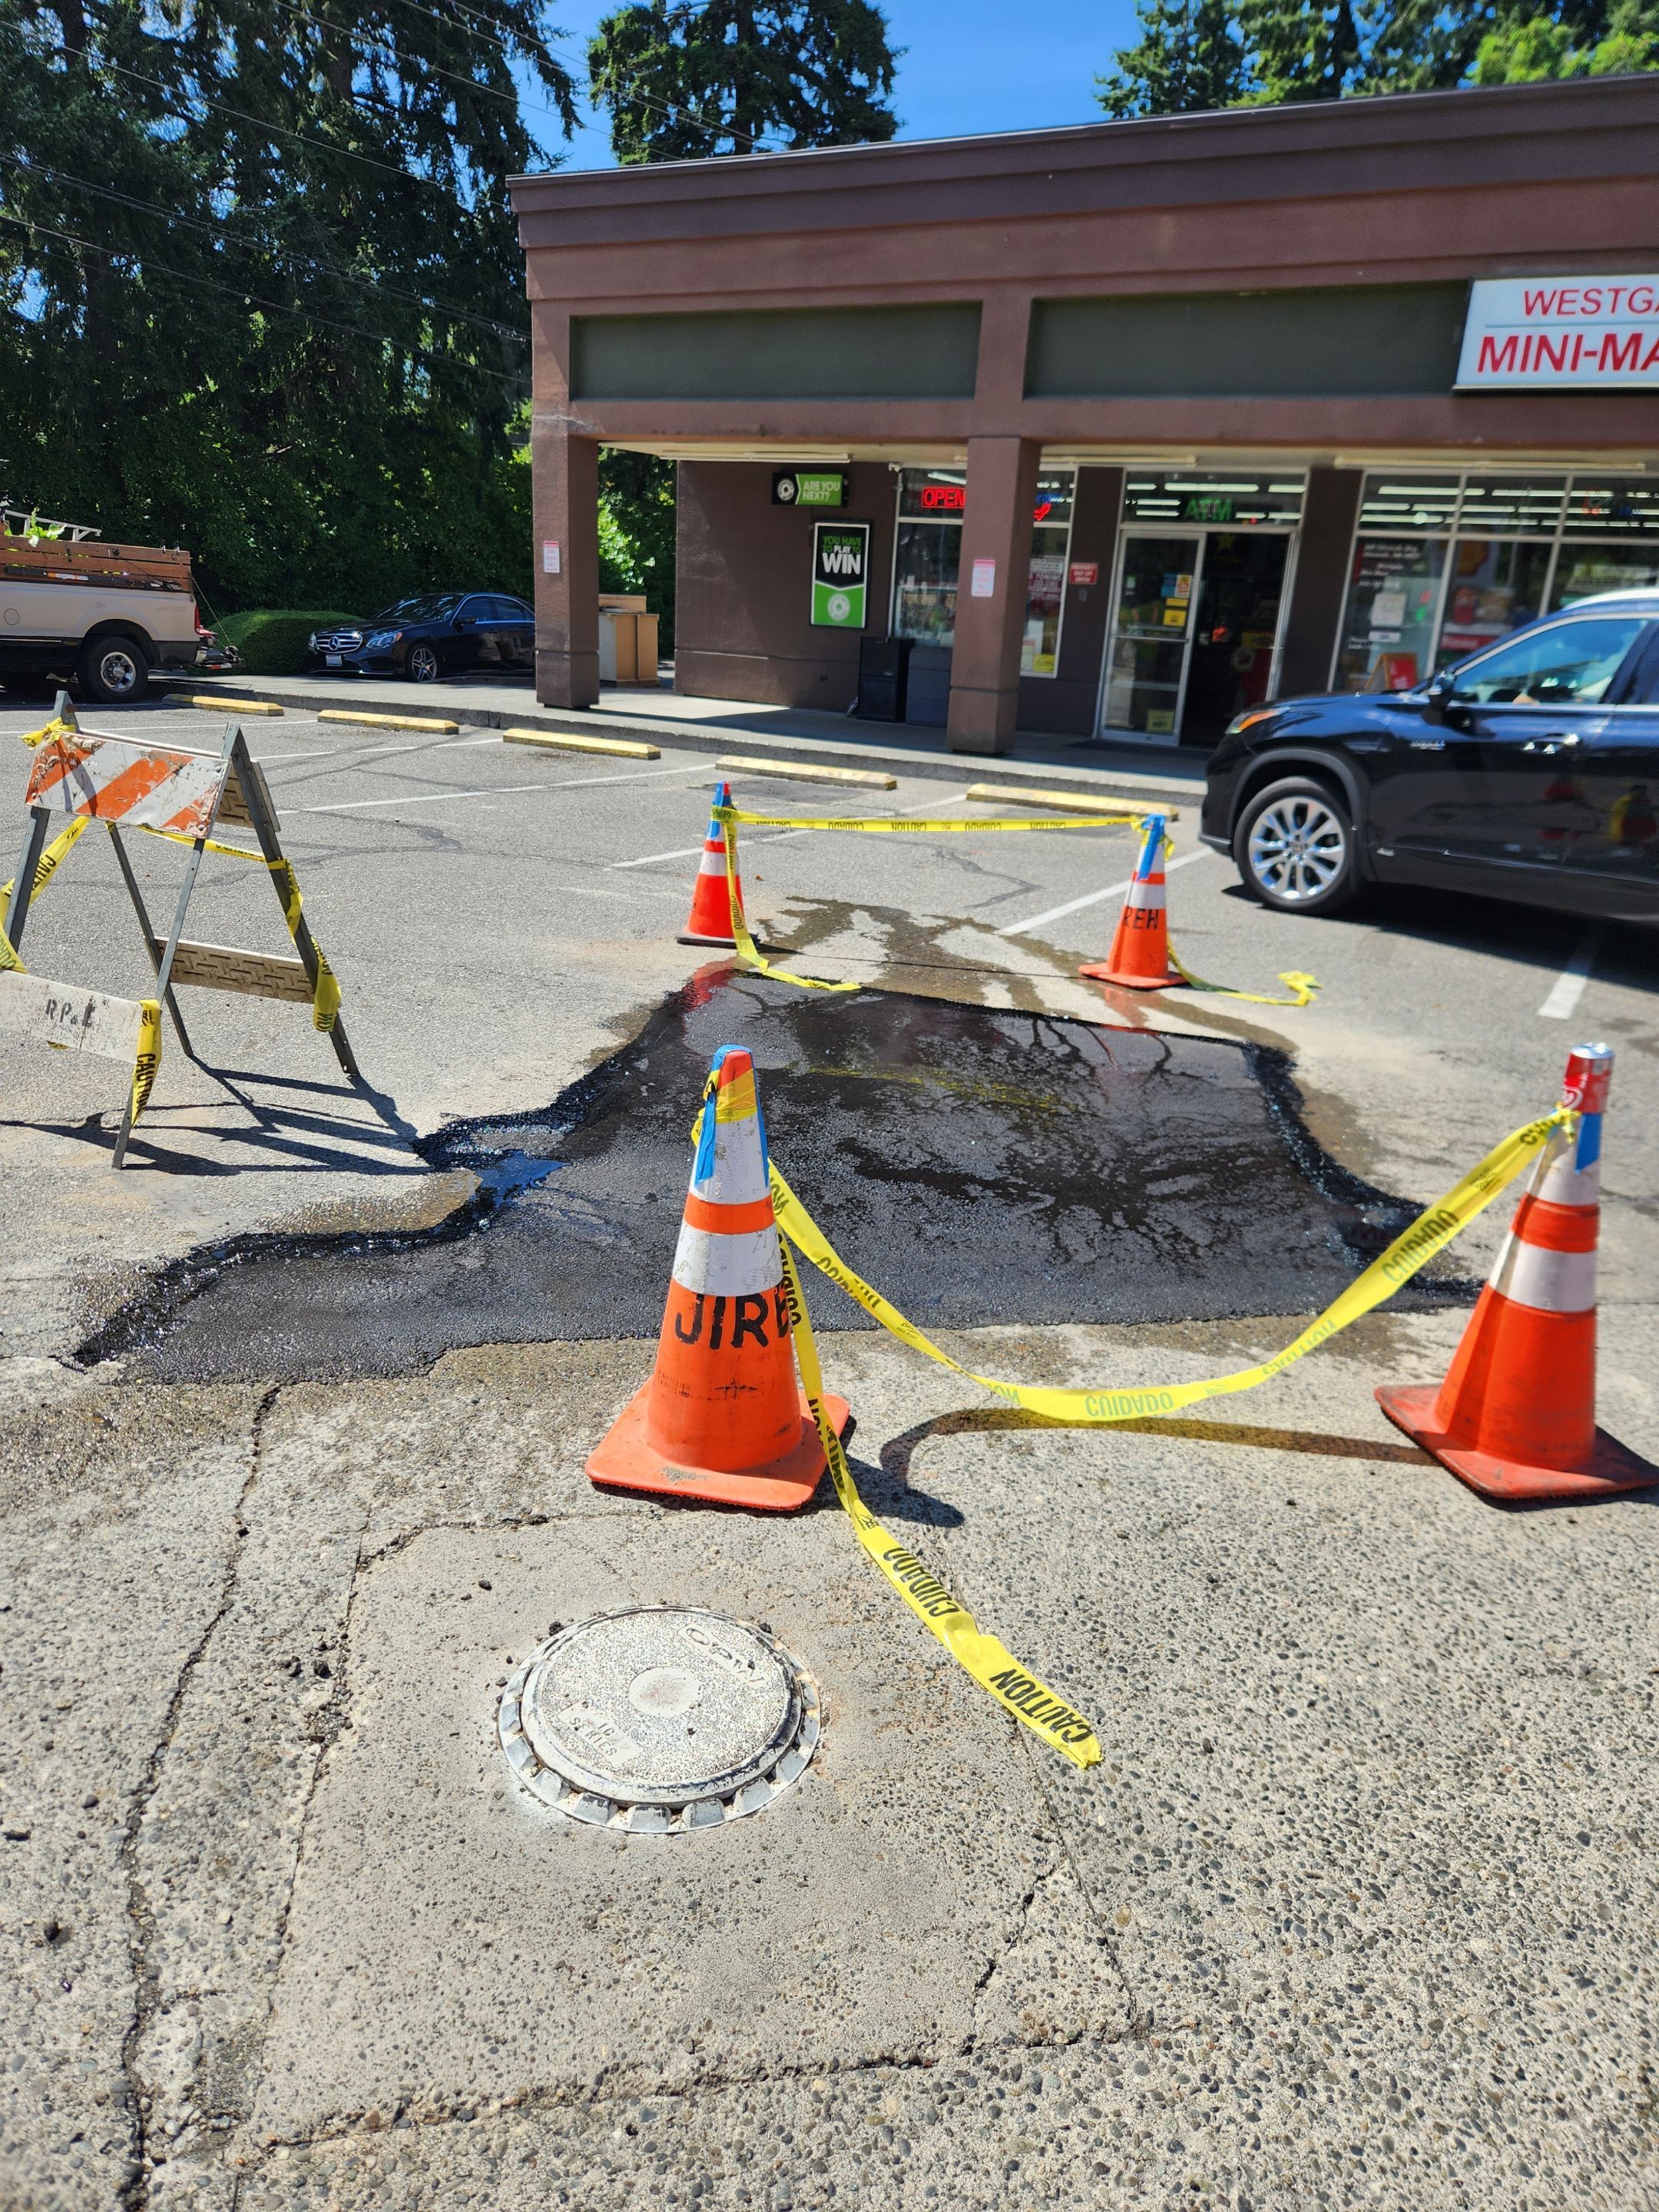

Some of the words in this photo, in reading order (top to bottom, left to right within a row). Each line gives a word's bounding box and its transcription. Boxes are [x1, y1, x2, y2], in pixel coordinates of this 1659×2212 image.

[1524, 286, 1659, 316] WESTG
[803, 480, 820, 492] ARE
[821, 481, 841, 492] YOU
[802, 491, 831, 502] NEXT?
[923, 489, 965, 507] OPEN
[823, 536, 840, 545] YOU
[833, 545, 852, 554] PLAY
[822, 552, 862, 575] WIN
[891, 821, 927, 833] CAUTION
[135, 1053, 157, 1113] CAUTION
[882, 1547, 960, 1618] CUIDADO
[988, 1667, 1094, 1743] CAUTION
